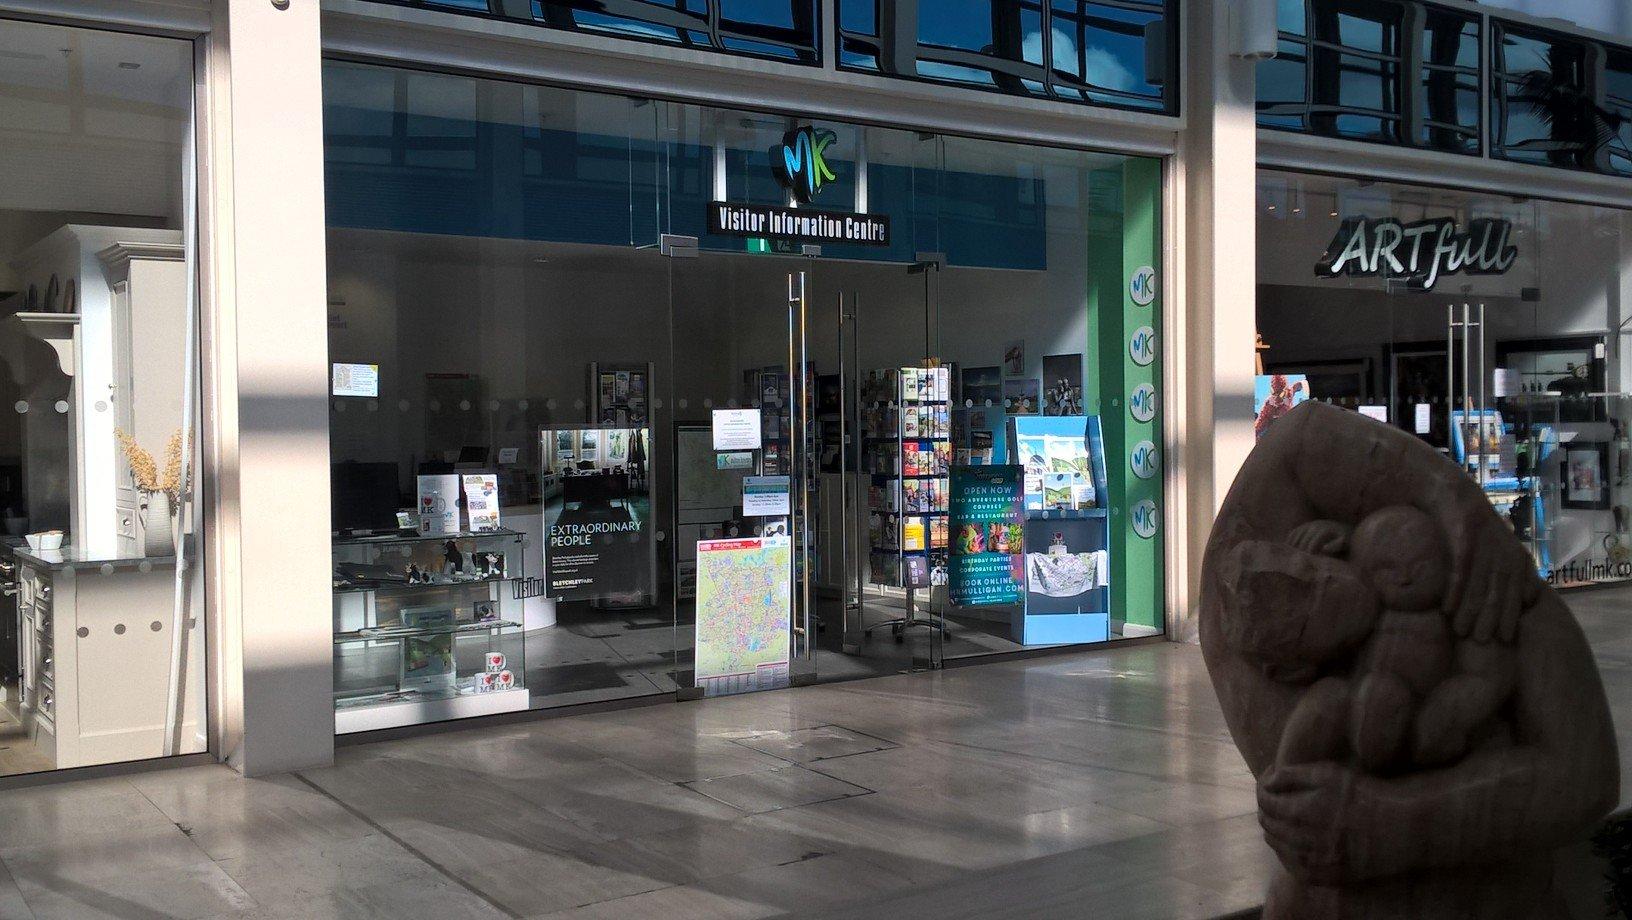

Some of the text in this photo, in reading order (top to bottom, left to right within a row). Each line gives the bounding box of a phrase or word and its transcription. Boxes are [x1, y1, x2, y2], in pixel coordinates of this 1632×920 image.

[783, 130, 837, 195] MK
[719, 206, 885, 241] Visitor Information Centre
[1331, 220, 1517, 289] ARTfull
[1133, 272, 1154, 299] MK
[1133, 332, 1154, 358] MK
[1133, 389, 1154, 414] MK
[1134, 446, 1155, 471] MK
[963, 486, 1012, 495] OPEN NOW
[551, 520, 642, 537] EXTRAORDINARY
[1135, 505, 1155, 532] MK
[551, 534, 592, 547] PEOPLE
[959, 577, 1013, 587] BOOK ONLINE
